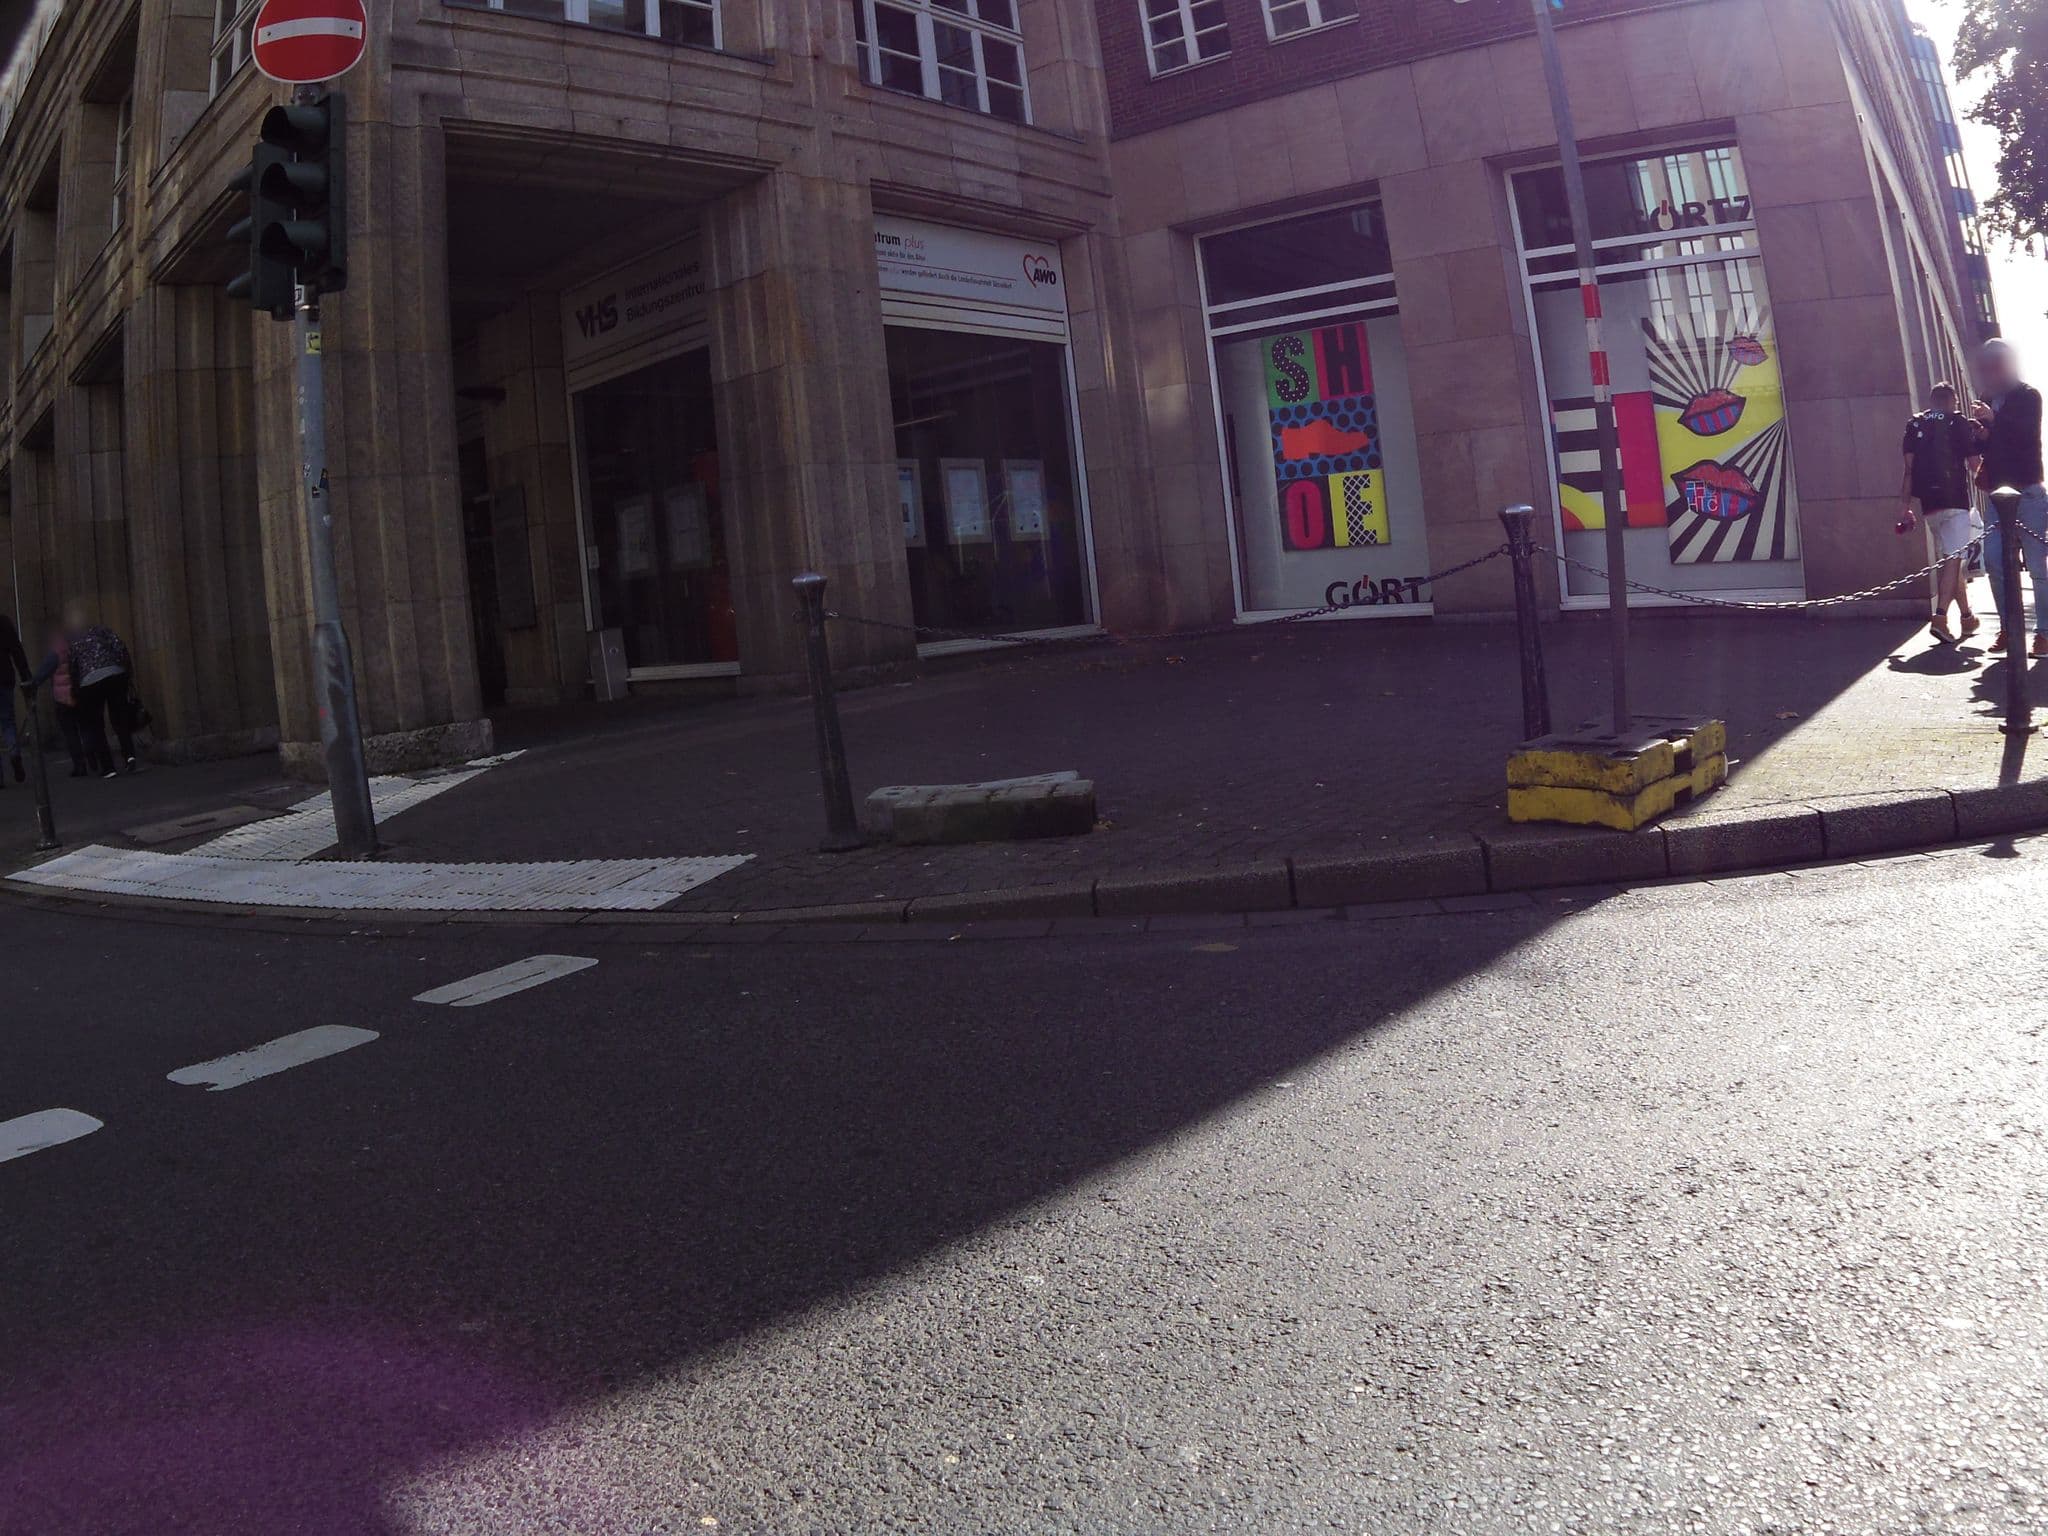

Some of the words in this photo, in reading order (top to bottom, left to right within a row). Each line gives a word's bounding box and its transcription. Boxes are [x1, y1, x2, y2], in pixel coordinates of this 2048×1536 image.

[904, 235, 926, 249] plus
[1033, 268, 1057, 285] AWO
[576, 293, 618, 337] VHS
